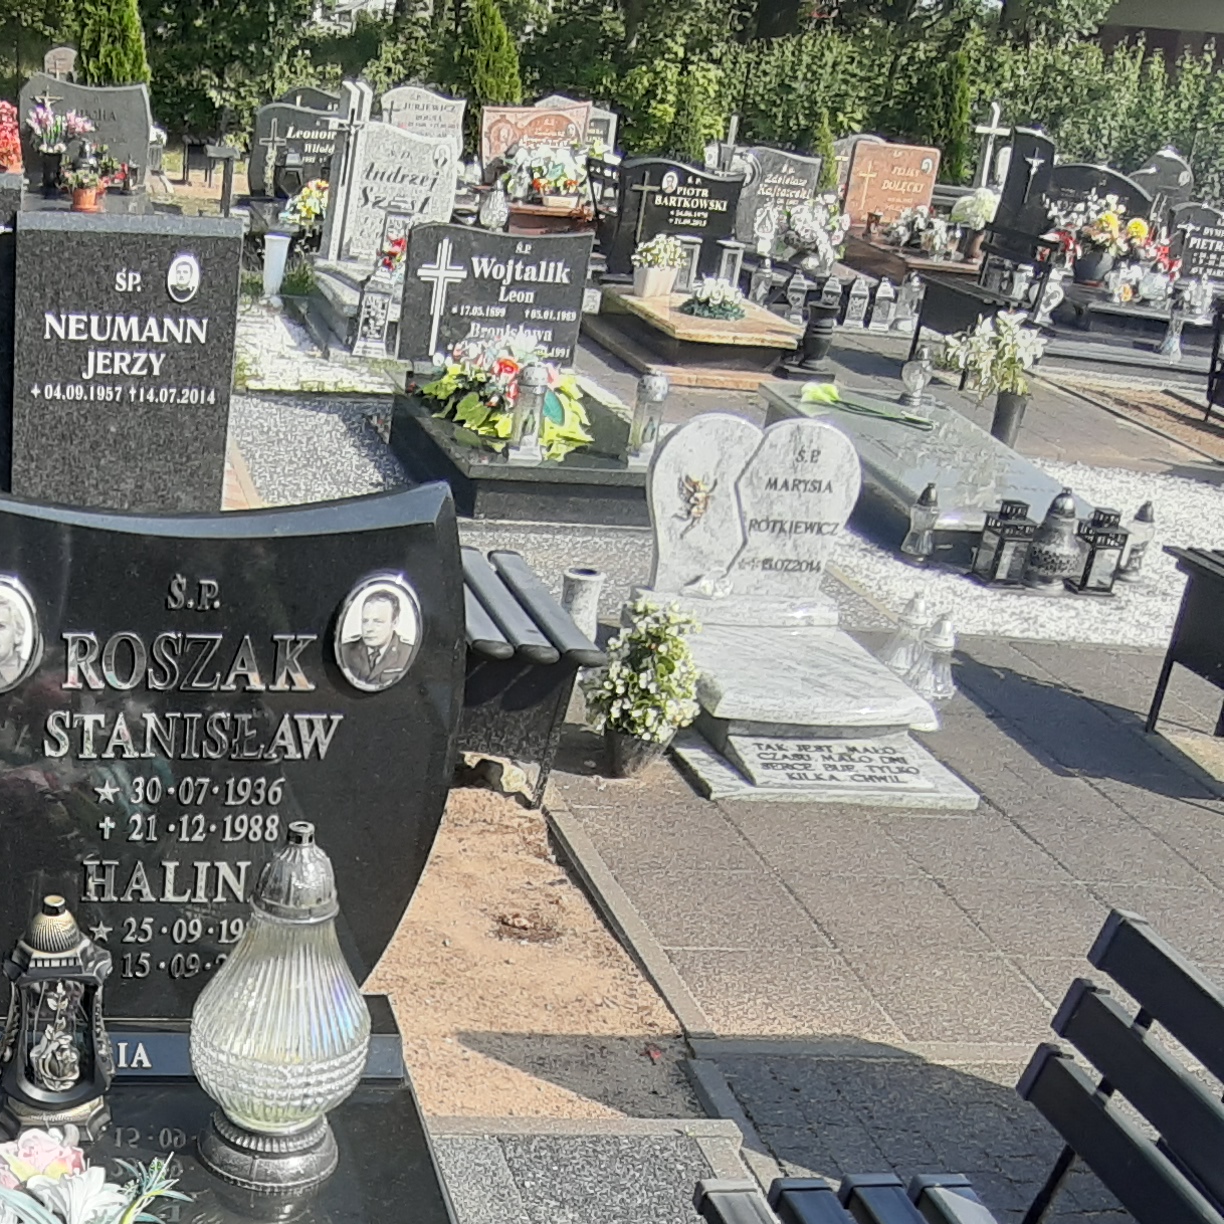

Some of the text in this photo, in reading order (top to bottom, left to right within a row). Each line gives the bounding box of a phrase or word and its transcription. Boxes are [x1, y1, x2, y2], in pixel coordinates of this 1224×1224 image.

[677, 187, 709, 197] PIOTR
[655, 195, 727, 211] BARTKOWSKI
[1189, 237, 1224, 251] PIETR
[471, 257, 570, 285] Wojtalik
[498, 286, 534, 303] Leon
[44, 313, 208, 344] NEUMANN
[82, 351, 166, 380] JERZY
[44, 385, 215, 404] 04.09.1957 14.07.2014
[765, 477, 833, 493] MARYSIA
[168, 574, 220, 609] Ś.P.
[62, 632, 317, 690] ROSZAK
[43, 711, 343, 759] STANISŁAW
[753, 743, 788, 752] TAK
[761, 763, 815, 771] SERCE
[866, 765, 919, 774] TYLKO
[786, 773, 907, 783] KILKA CHWIL
[82, 861, 251, 902] HALIN
